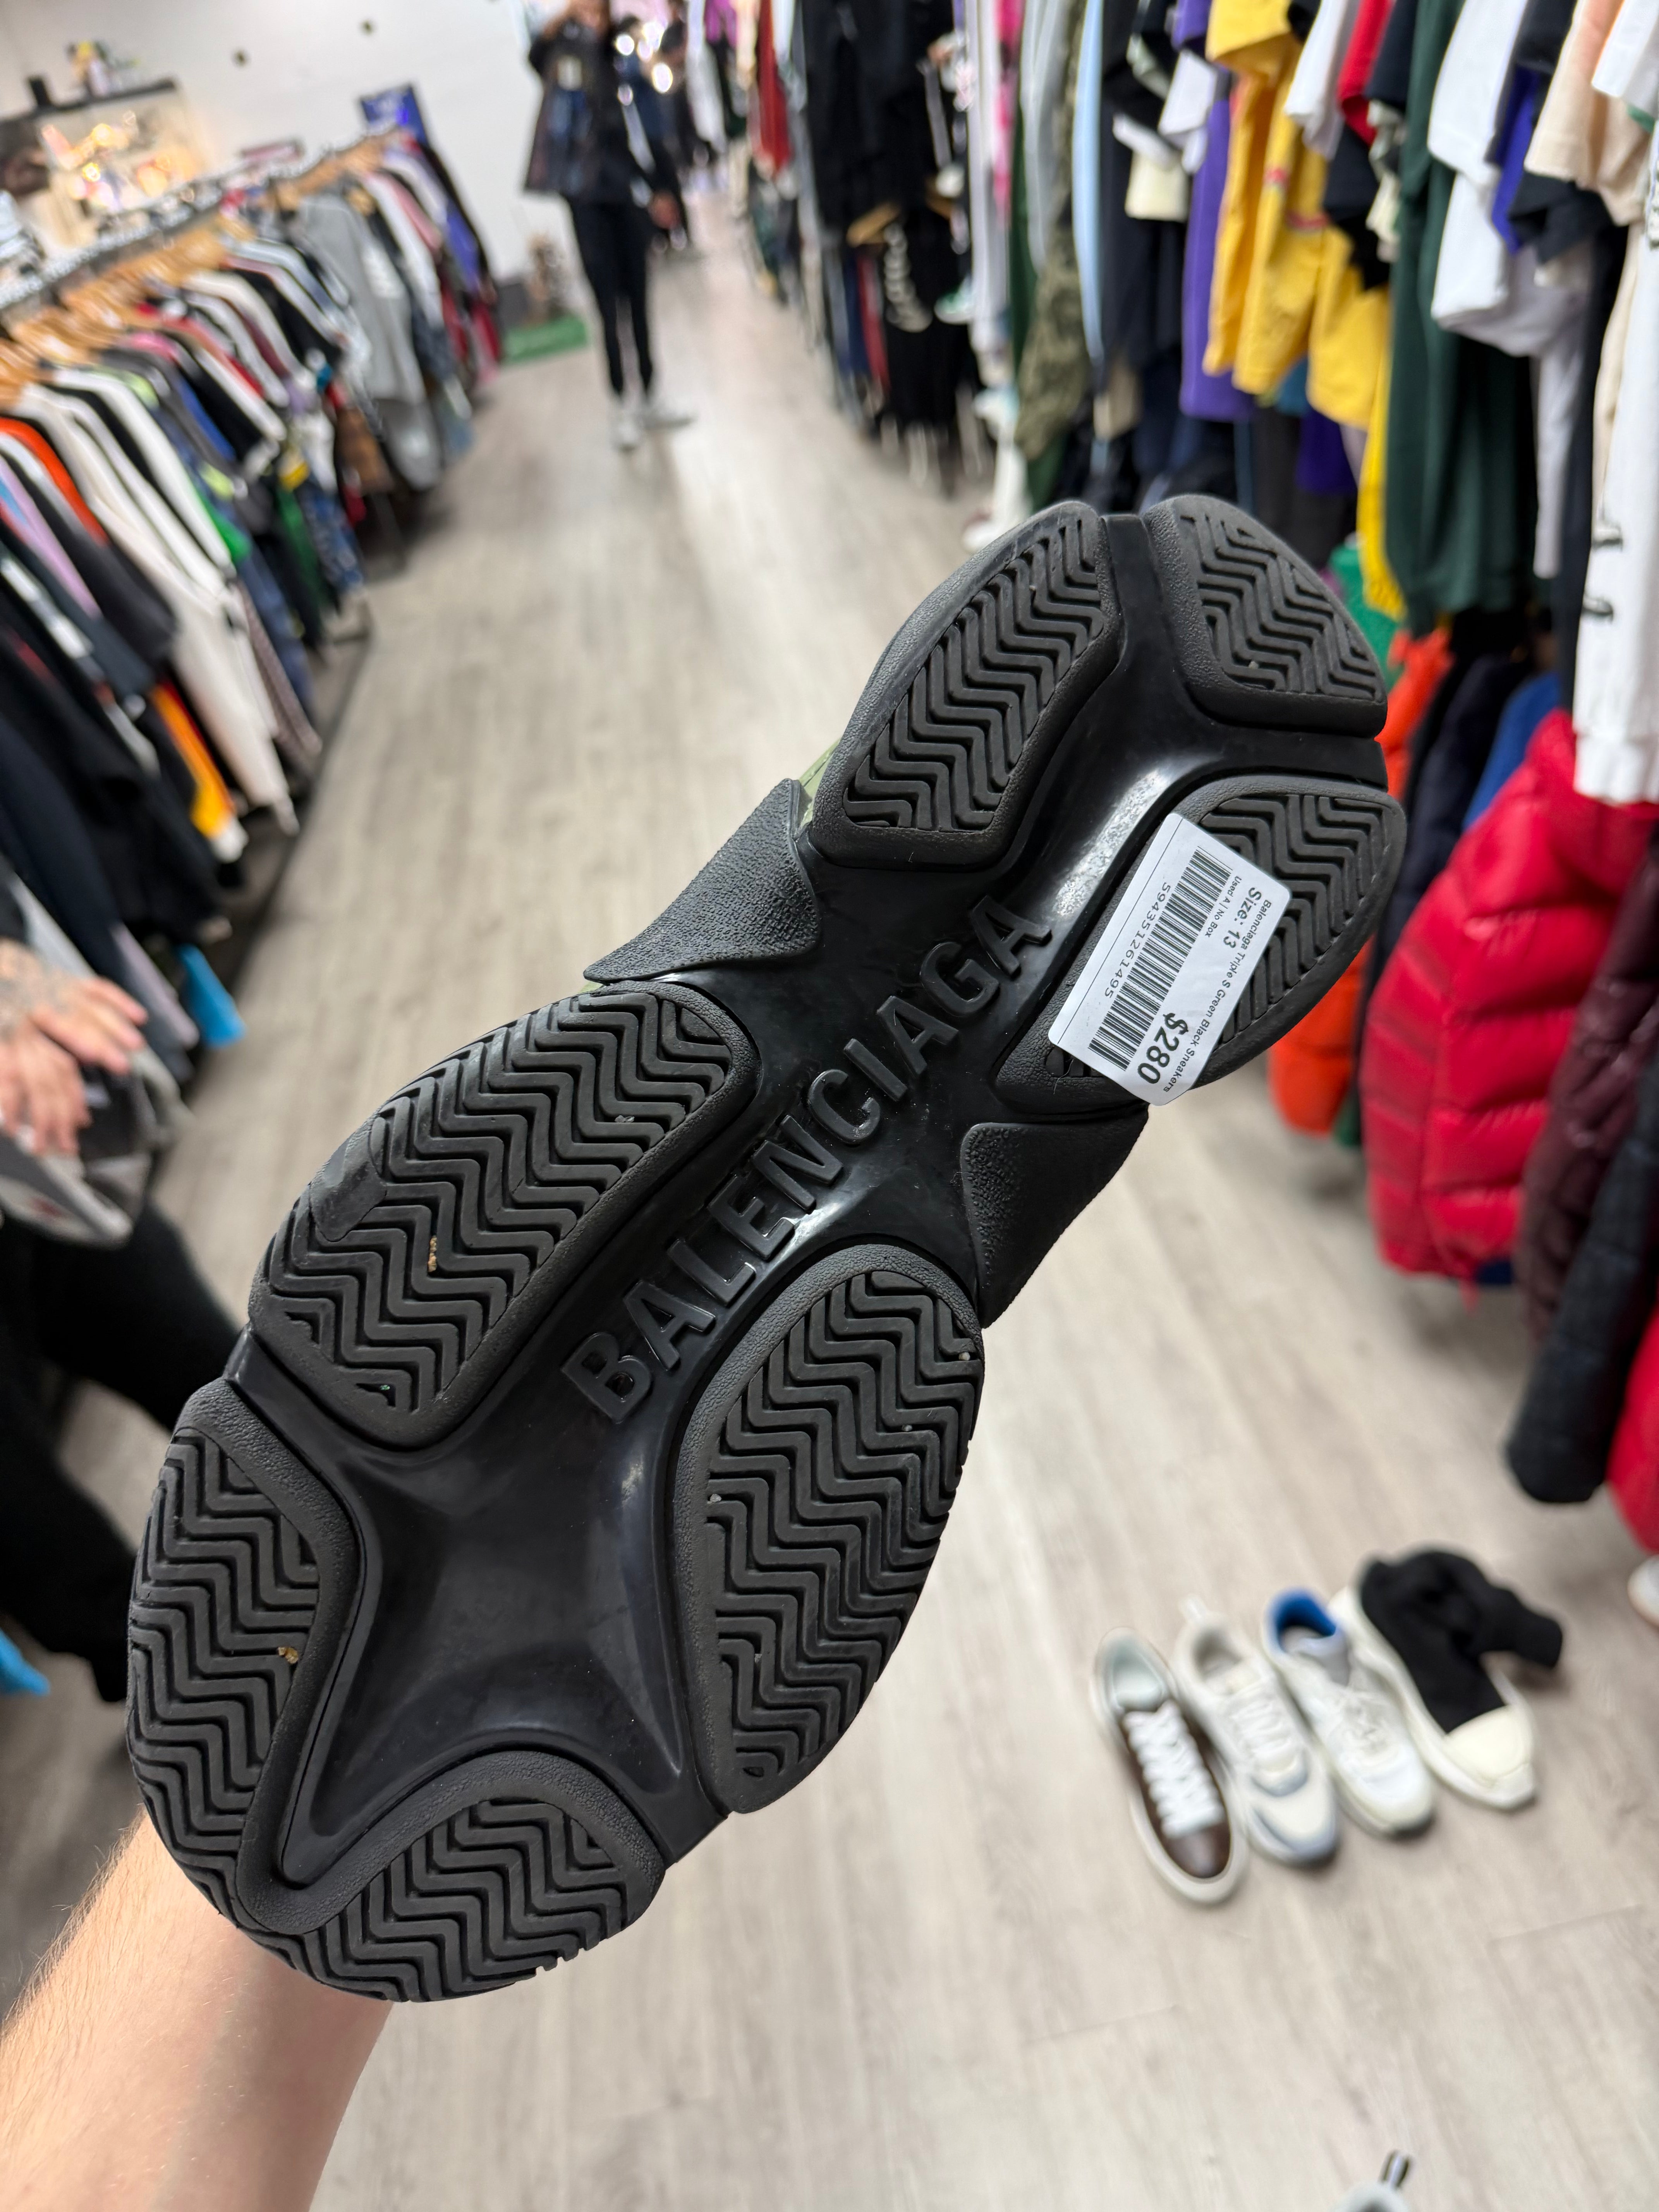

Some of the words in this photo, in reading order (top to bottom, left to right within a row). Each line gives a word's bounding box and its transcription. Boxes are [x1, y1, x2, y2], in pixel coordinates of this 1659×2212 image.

[1227, 876, 1242, 897] Used
[1214, 908, 1224, 920] No
[1234, 887, 1262, 925] Size:
[1205, 921, 1218, 938] Box
[1240, 899, 1272, 950] Balenciaga
[1104, 882, 1171, 998] 594351261495
[1223, 930, 1240, 948] 13
[1226, 952, 1245, 978] Triple
[1222, 979, 1230, 988] S
[1205, 989, 1226, 1017] Green
[1190, 1018, 1210, 1046] Black
[1137, 1012, 1189, 1084] $280
[1163, 1048, 1195, 1092] Sneakers
[561, 895, 1051, 1423] BALENCIAGA
